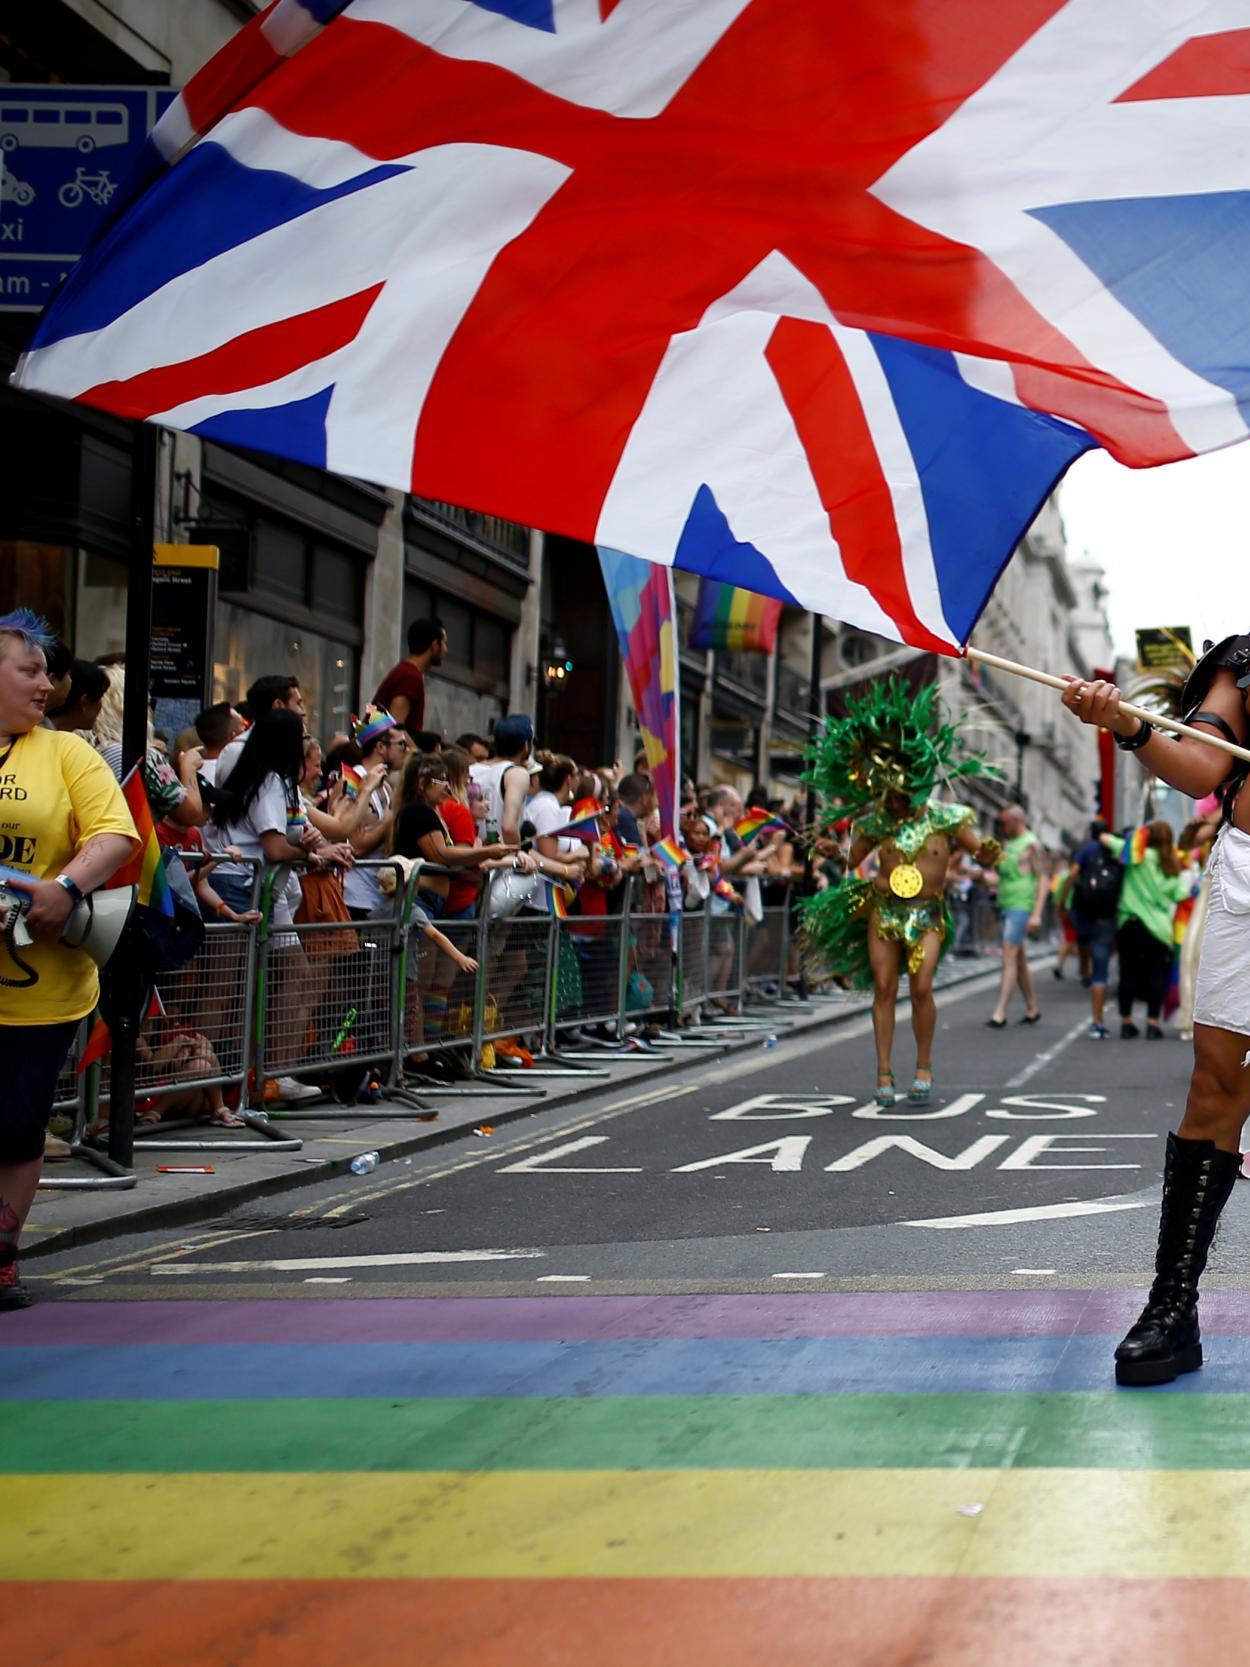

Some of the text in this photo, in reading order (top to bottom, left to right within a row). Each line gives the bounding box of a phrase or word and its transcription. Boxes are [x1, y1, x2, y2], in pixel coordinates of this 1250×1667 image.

[0, 276, 29, 293] m
[2, 822, 20, 830] our
[707, 1093, 1107, 1120] BUS
[495, 1134, 1159, 1173] LANE
